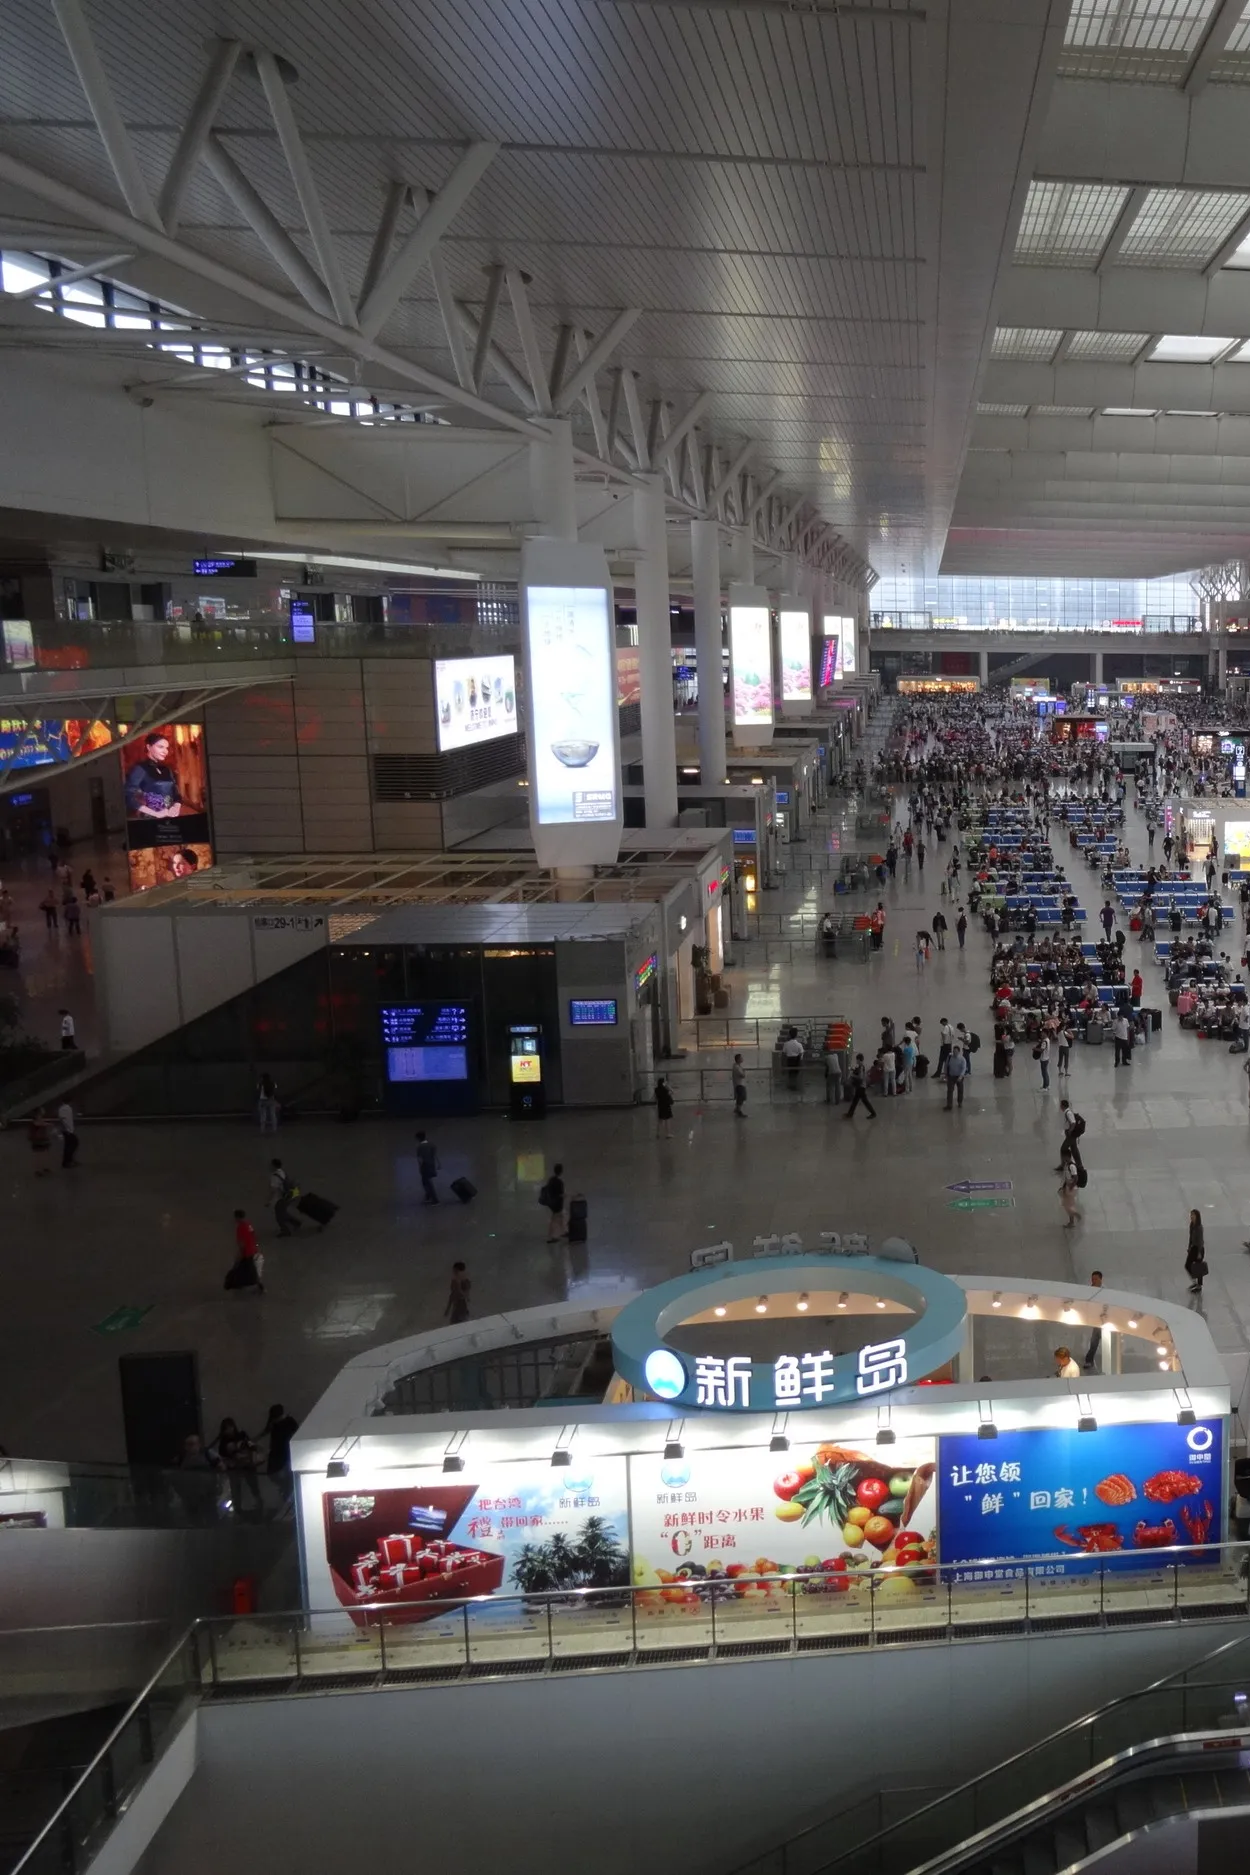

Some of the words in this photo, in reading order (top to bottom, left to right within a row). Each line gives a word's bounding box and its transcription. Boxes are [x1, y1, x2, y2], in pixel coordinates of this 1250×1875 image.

[274, 916, 295, 929] 29-1
[695, 1338, 908, 1407] 新鲜岛
[950, 1461, 1021, 1487] 让您领
[478, 1496, 522, 1511] 把台湾
[558, 1496, 601, 1509] 新鲜岛
[656, 1492, 697, 1504] 新鲜岛
[663, 1507, 766, 1527] 新鲜时令水果
